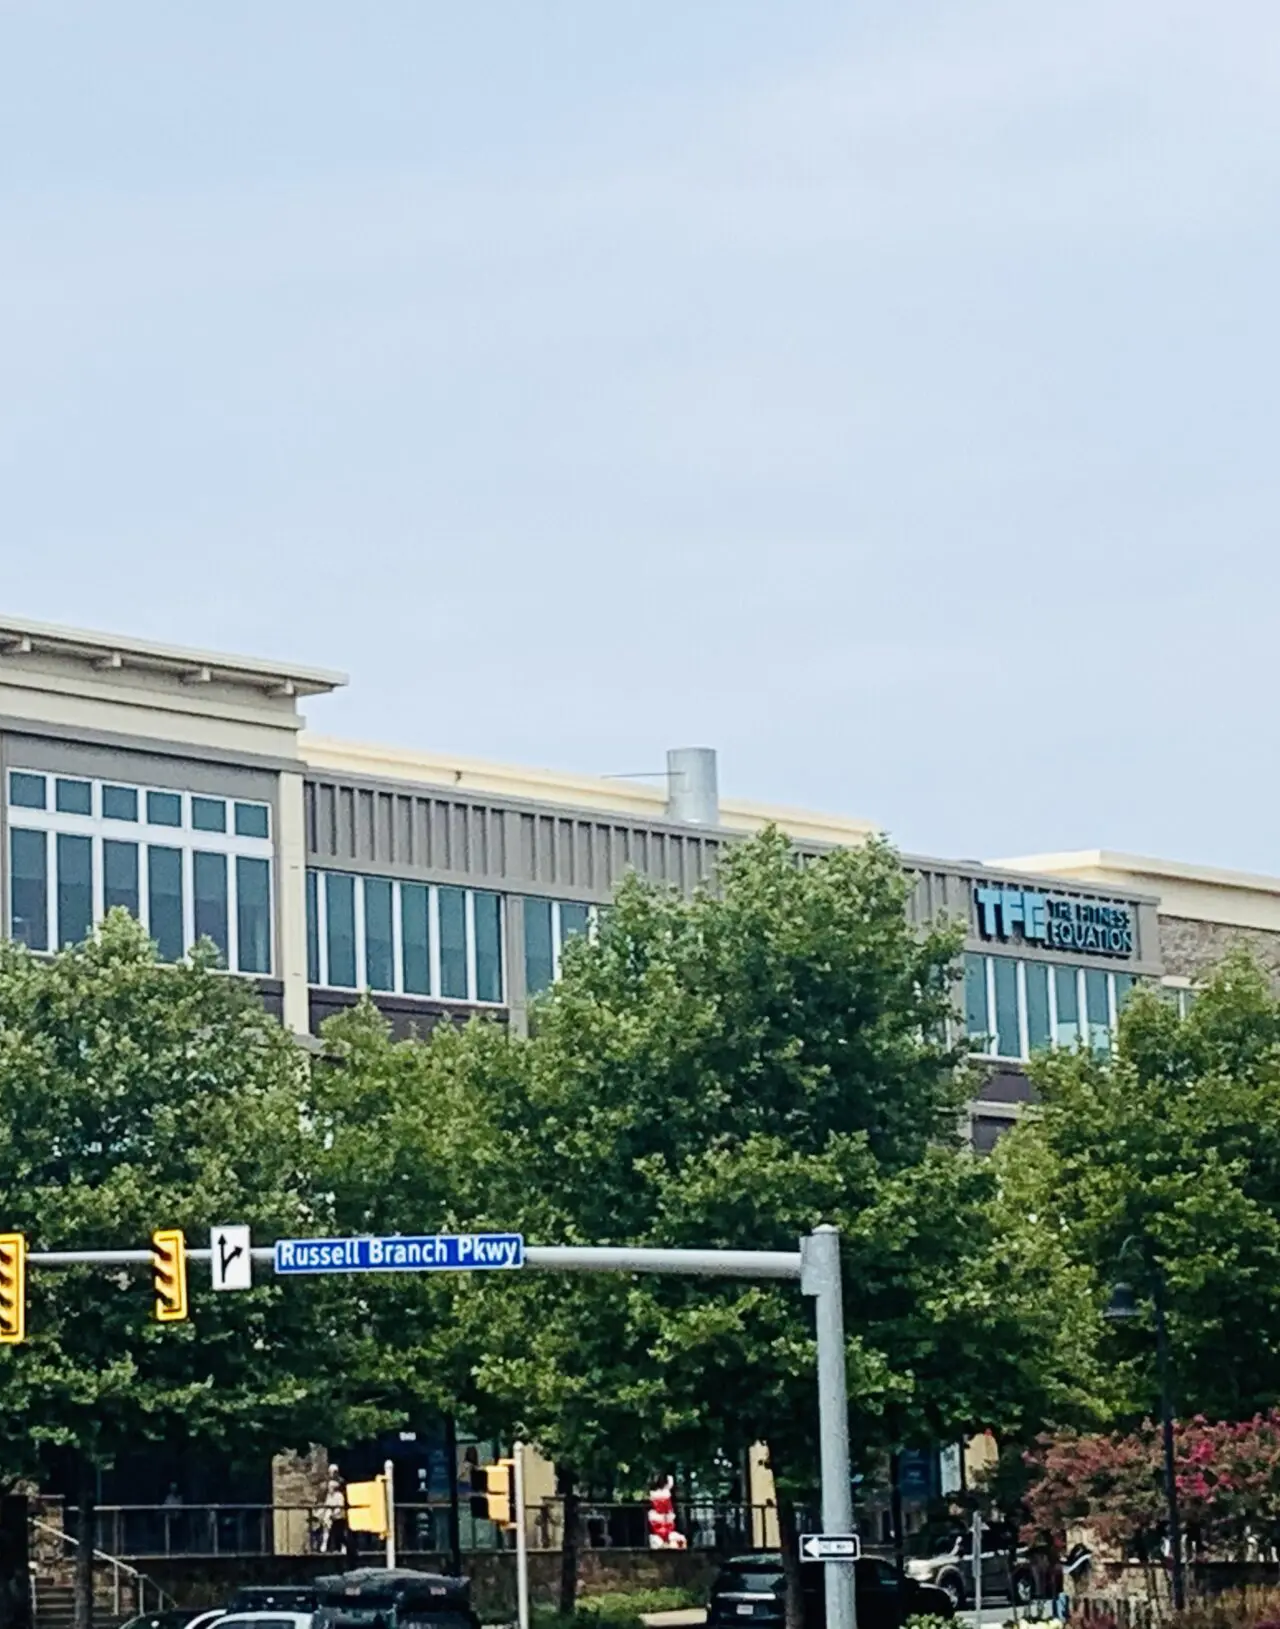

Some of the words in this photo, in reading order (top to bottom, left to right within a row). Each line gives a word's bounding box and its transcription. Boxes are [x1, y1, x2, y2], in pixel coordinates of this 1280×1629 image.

[1048, 921, 1132, 952] EQUATION
[281, 1241, 361, 1266] Russell
[370, 1238, 448, 1263] Branch
[458, 1236, 517, 1266] Pkwy
